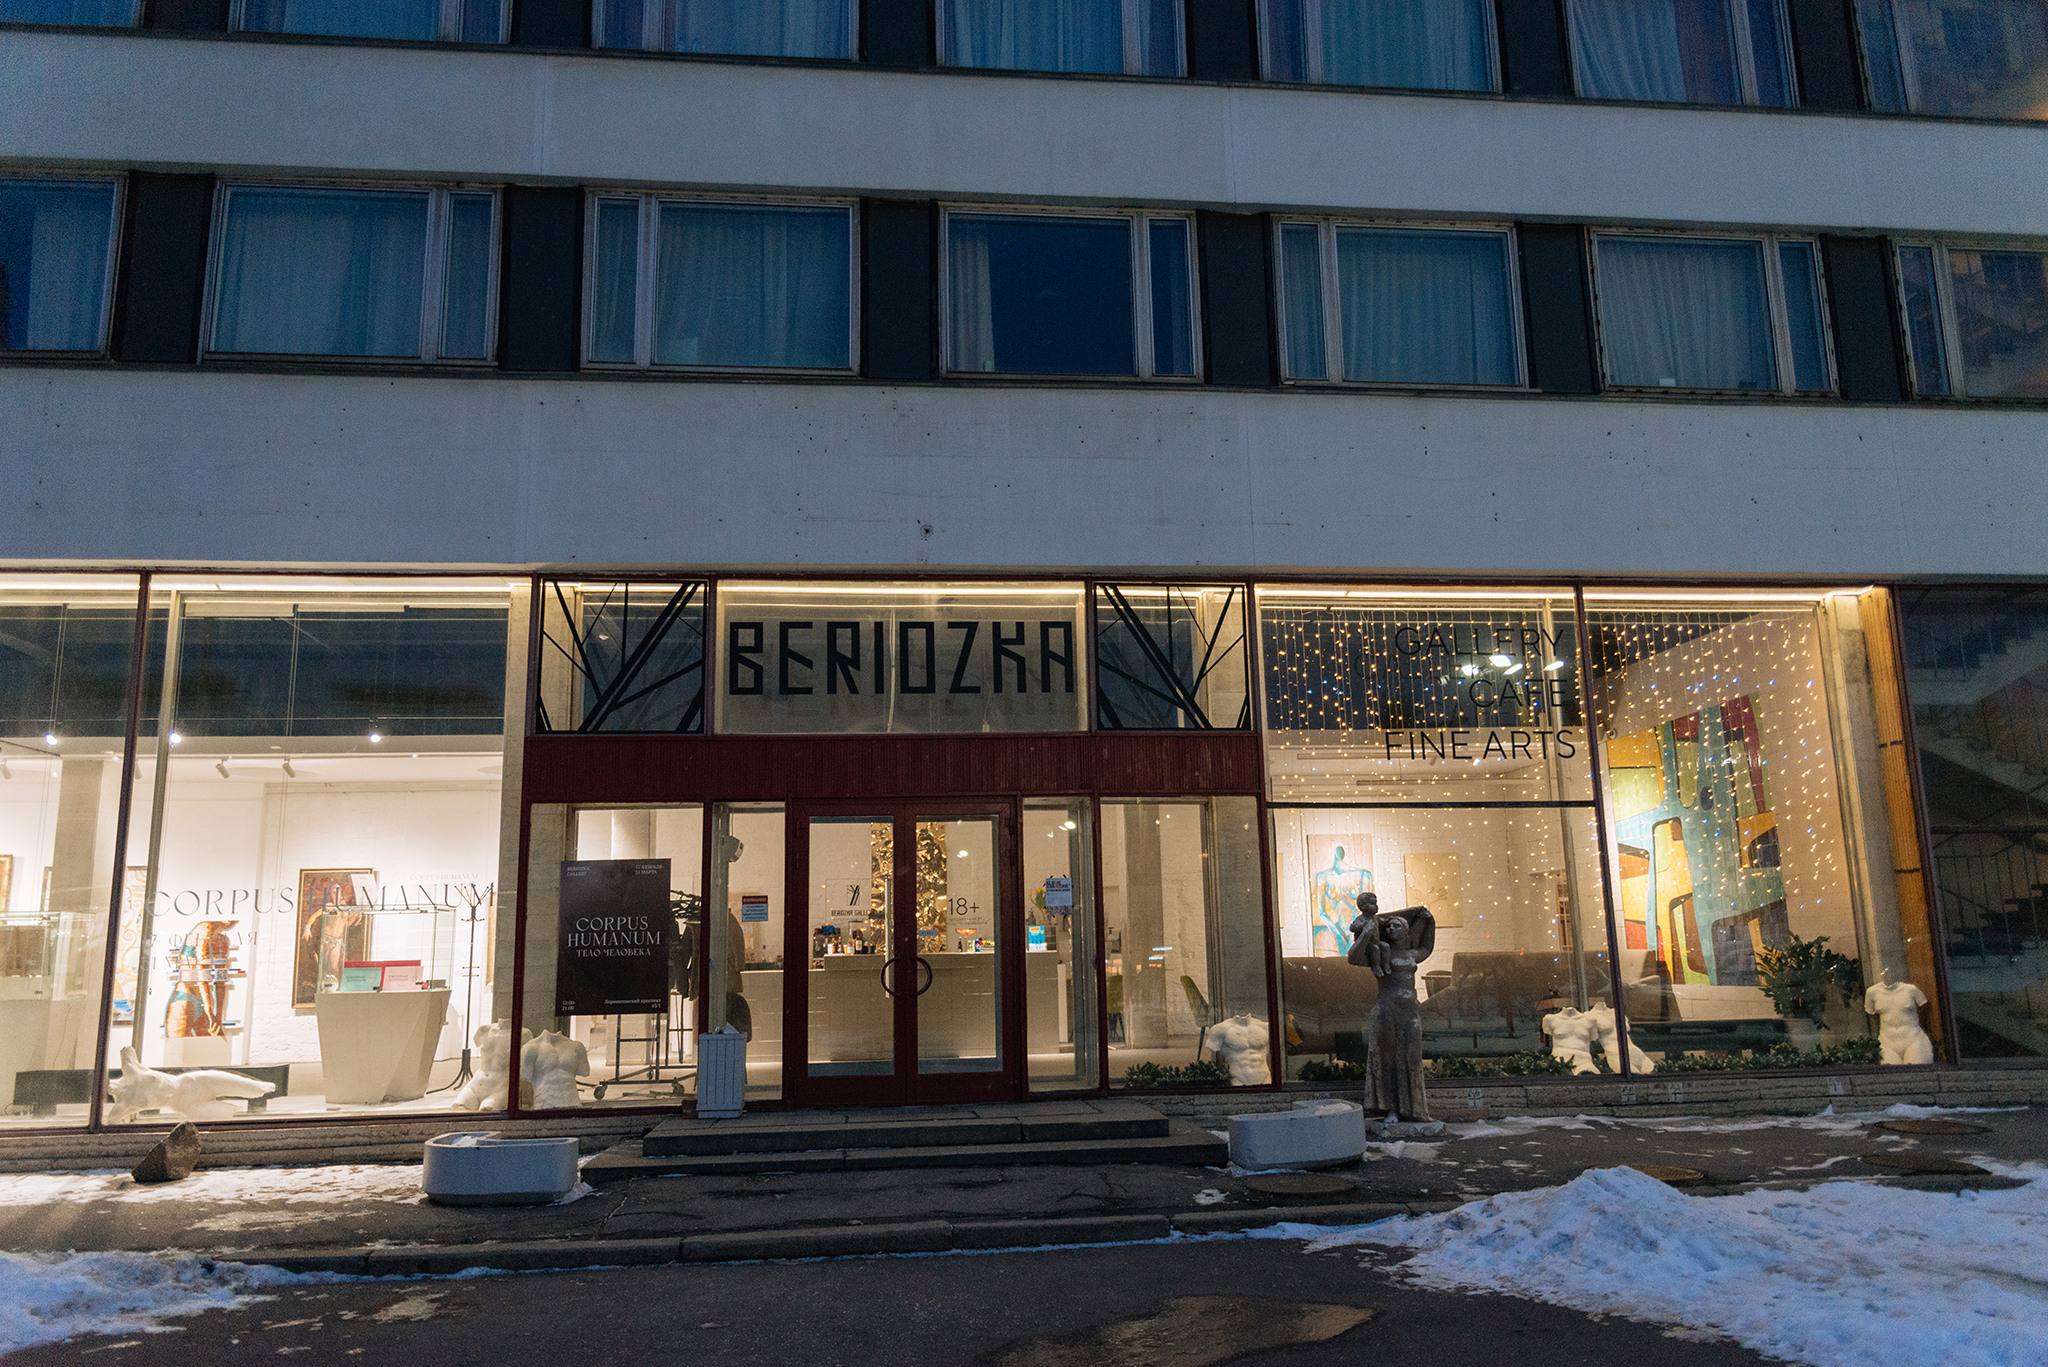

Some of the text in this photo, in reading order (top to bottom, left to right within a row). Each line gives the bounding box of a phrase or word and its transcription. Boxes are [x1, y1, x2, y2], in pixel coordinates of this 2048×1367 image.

[1394, 627, 1564, 657] GALLERY
[729, 621, 1074, 695] BERIOZKA
[1469, 679, 1568, 708] CAFE
[1385, 729, 1576, 760] FINE ARTS
[145, 883, 495, 917] CORPUS HUMANUM
[947, 897, 980, 916] 18+
[576, 916, 649, 931] CORPUS
[567, 931, 661, 947] HUMANUM
[576, 948, 651, 957] ТЕЛО ЧЕЛОВЕКА
